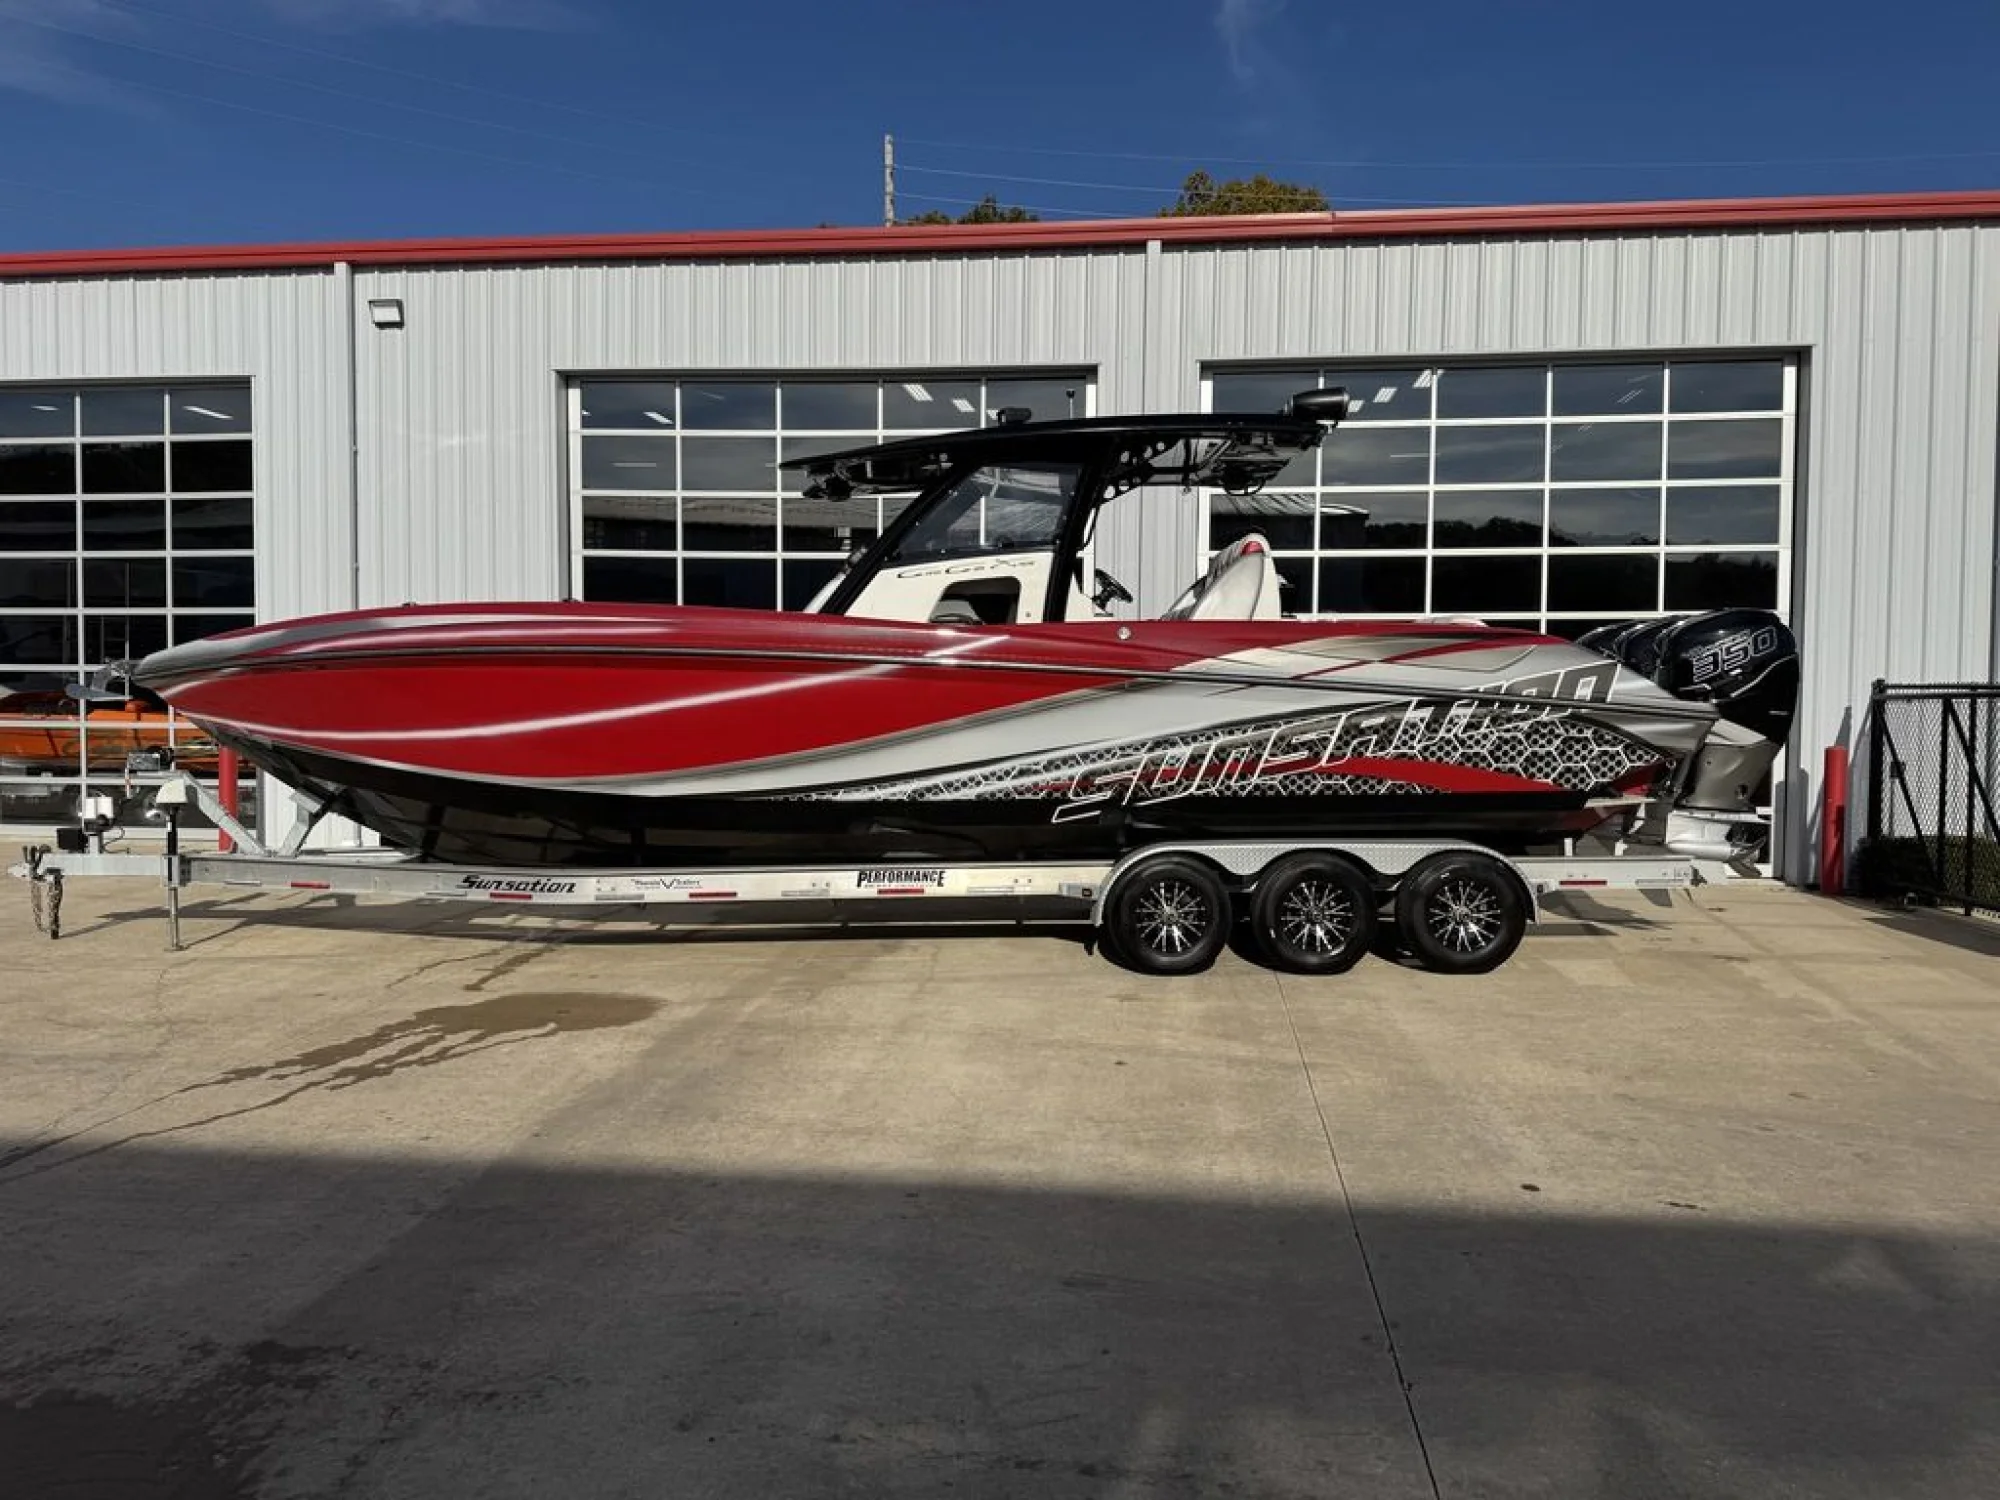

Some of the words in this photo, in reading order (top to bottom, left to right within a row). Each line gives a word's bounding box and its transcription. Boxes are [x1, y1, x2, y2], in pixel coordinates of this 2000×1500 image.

[1693, 625, 1778, 682] 350
[457, 875, 577, 893] Sunsation
[857, 869, 946, 888] PERFORMANCE
